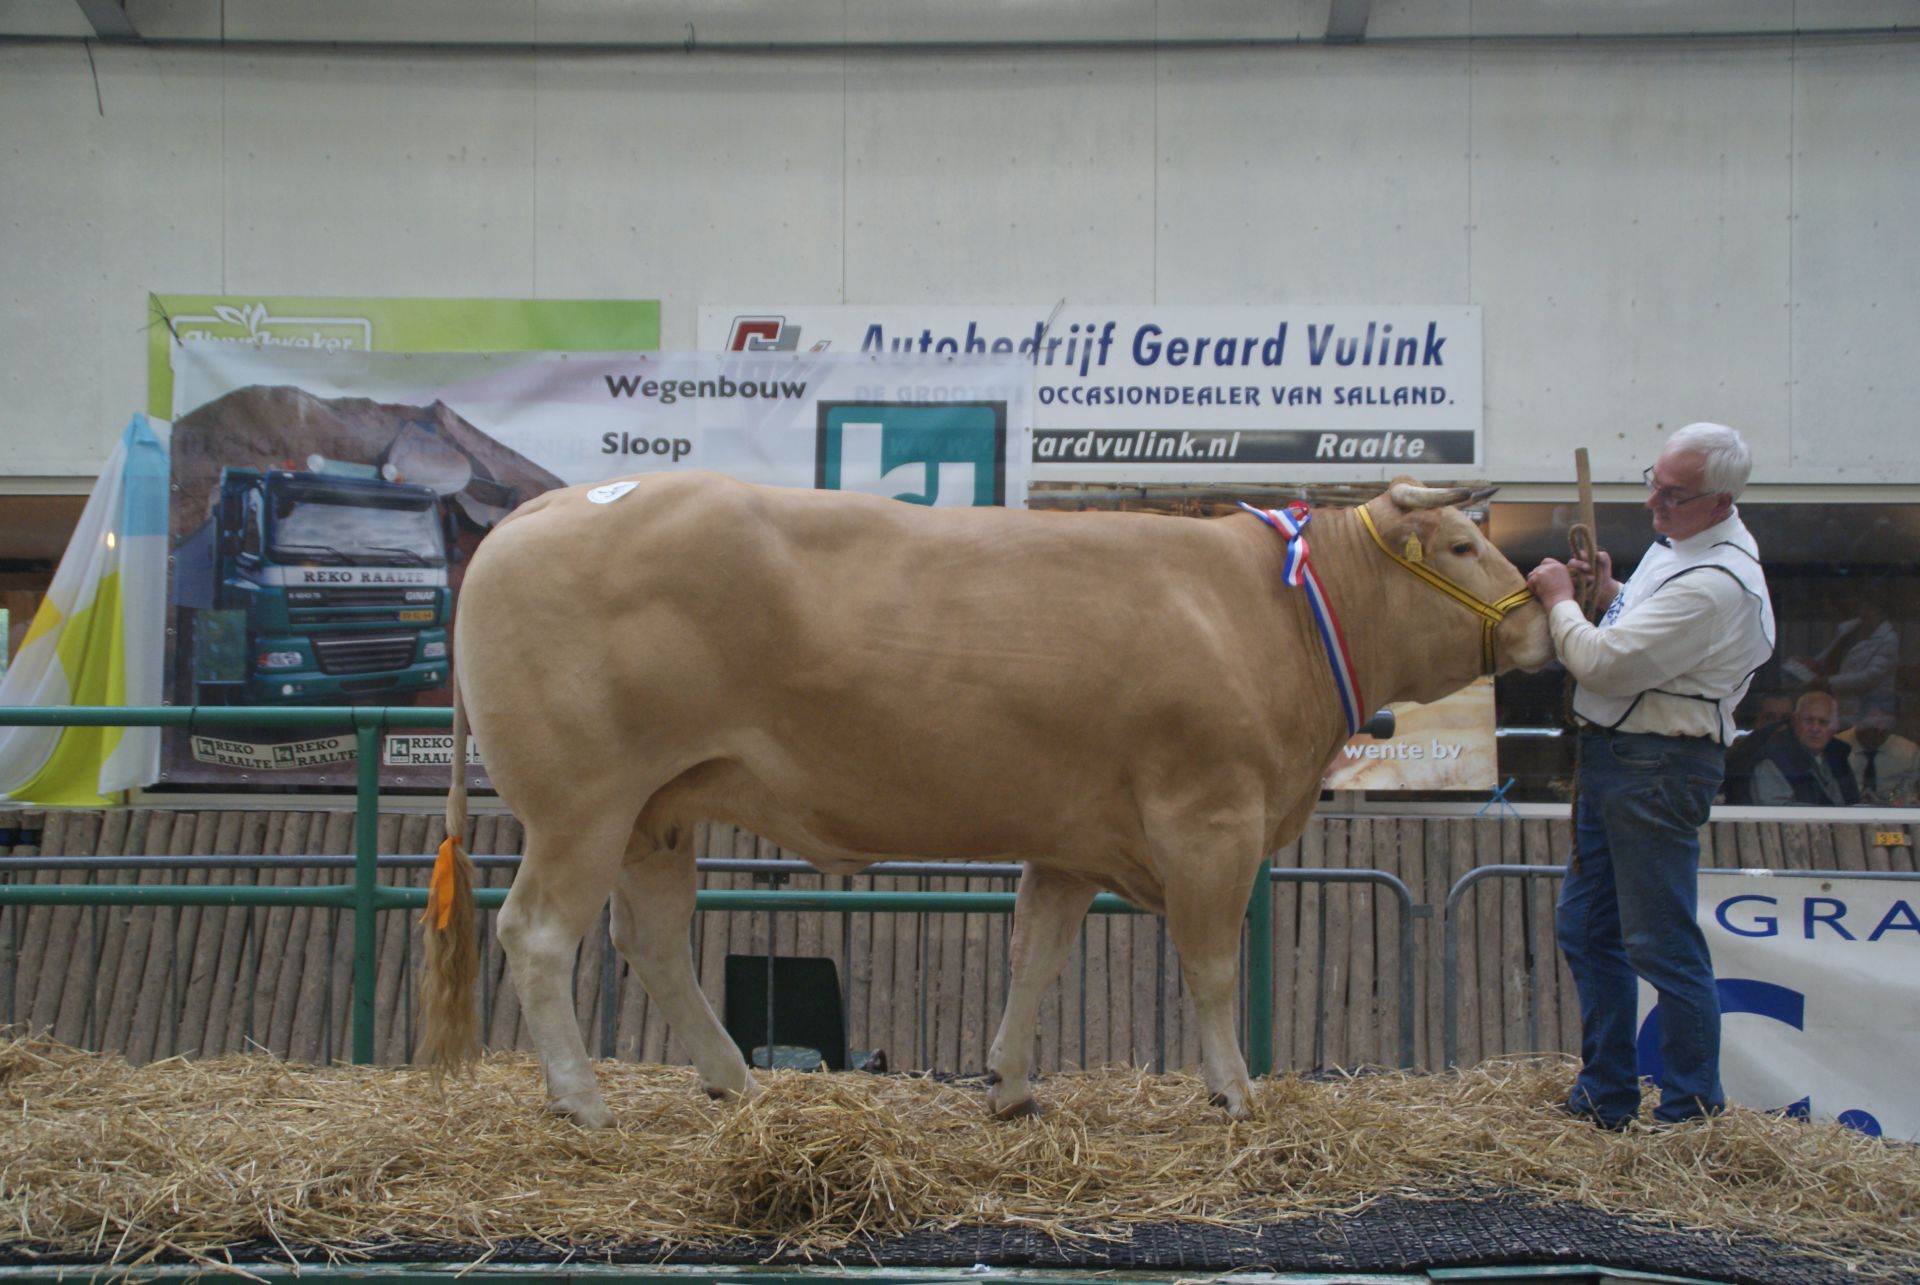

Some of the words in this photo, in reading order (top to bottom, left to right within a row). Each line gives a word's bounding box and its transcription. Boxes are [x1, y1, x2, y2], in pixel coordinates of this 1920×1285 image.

[1132, 321, 1288, 366] Gerard
[1307, 321, 1447, 366] Vulink
[604, 374, 807, 404] Wegenbouw
[1038, 386, 1261, 406] OCCASIONDEALER
[1272, 386, 1322, 406] VAN
[1334, 386, 1454, 406] SALLAND.
[601, 431, 692, 462] Sloop
[1315, 432, 1425, 458] Raalte
[304, 571, 352, 583] REKO
[215, 741, 255, 755] REKO
[294, 738, 339, 754] REKO
[411, 737, 454, 749] REKO
[1431, 738, 1463, 760] bv
[218, 754, 273, 769] RAALTE
[297, 749, 358, 767] RAALTE
[411, 753, 470, 764] RAAL
